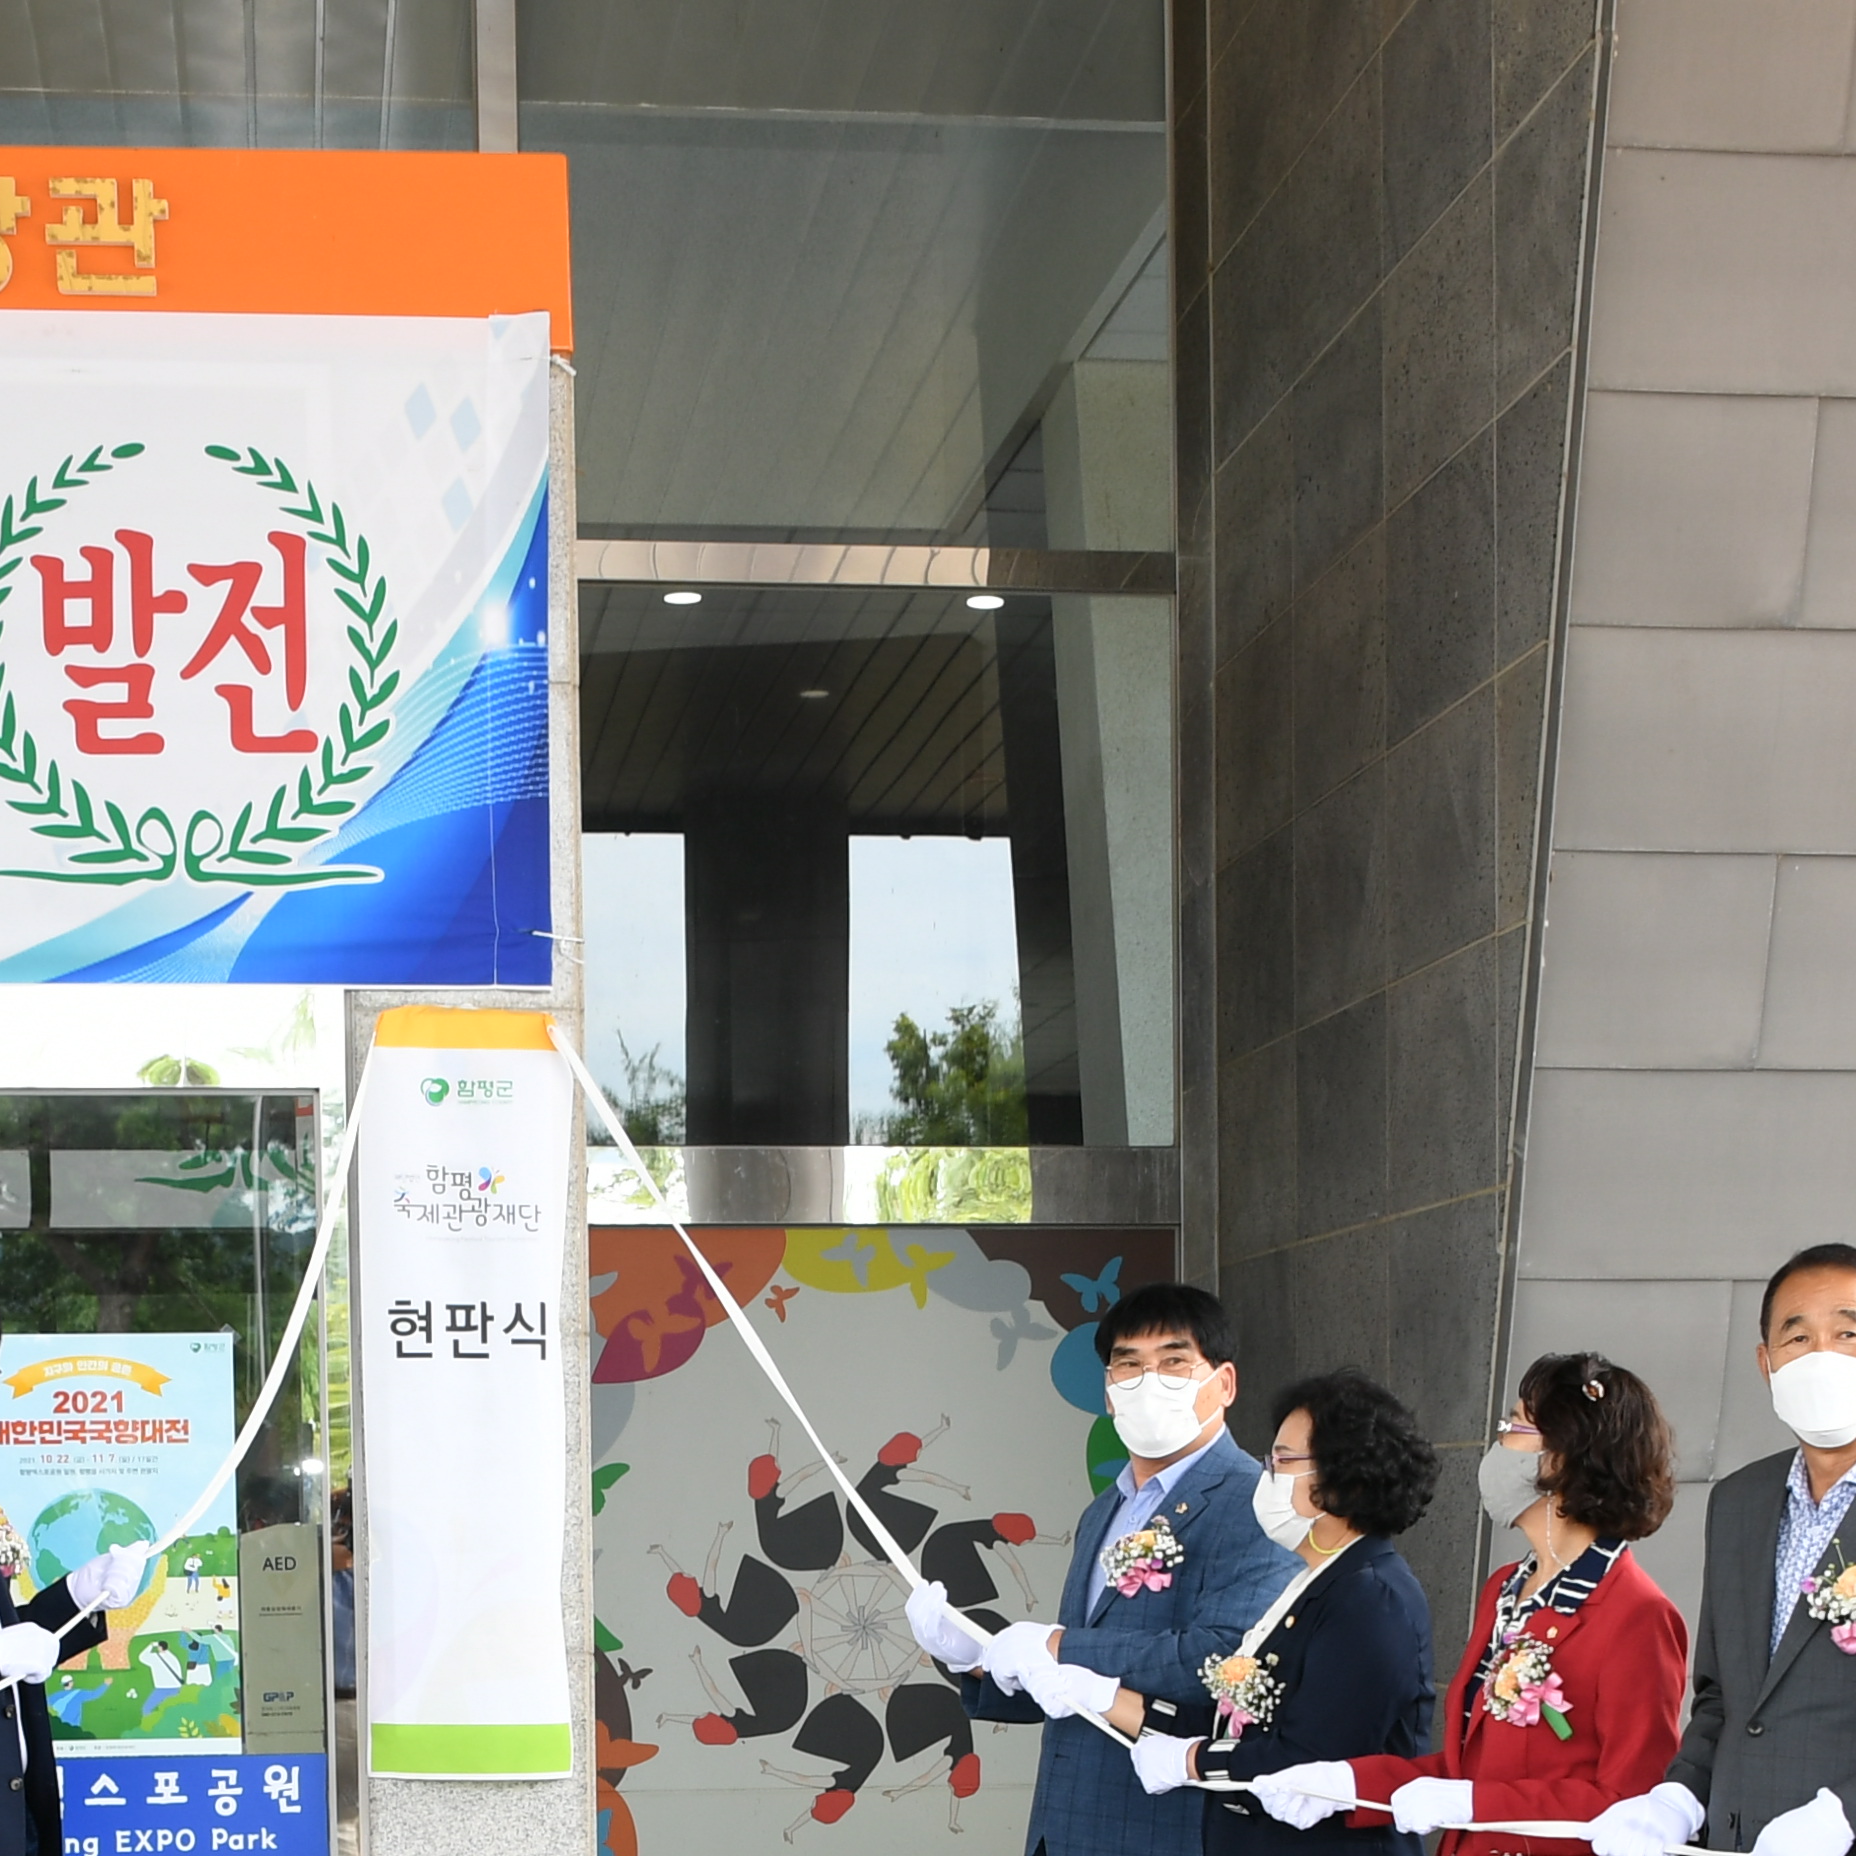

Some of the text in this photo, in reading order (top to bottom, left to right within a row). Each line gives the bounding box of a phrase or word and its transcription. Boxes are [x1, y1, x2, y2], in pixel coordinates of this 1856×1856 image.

[30, 528, 319, 757] 발전
[457, 1079, 514, 1099] 함평군
[425, 1164, 474, 1201] 함평
[393, 1187, 542, 1233] 축제관광재단
[387, 1299, 548, 1361] 현판식
[52, 1390, 125, 1414] 2021
[262, 1556, 297, 1572] AED
[55, 1764, 303, 1819] 스포공원
[115, 1828, 197, 1853] EXPO
[211, 1827, 279, 1851] Park
